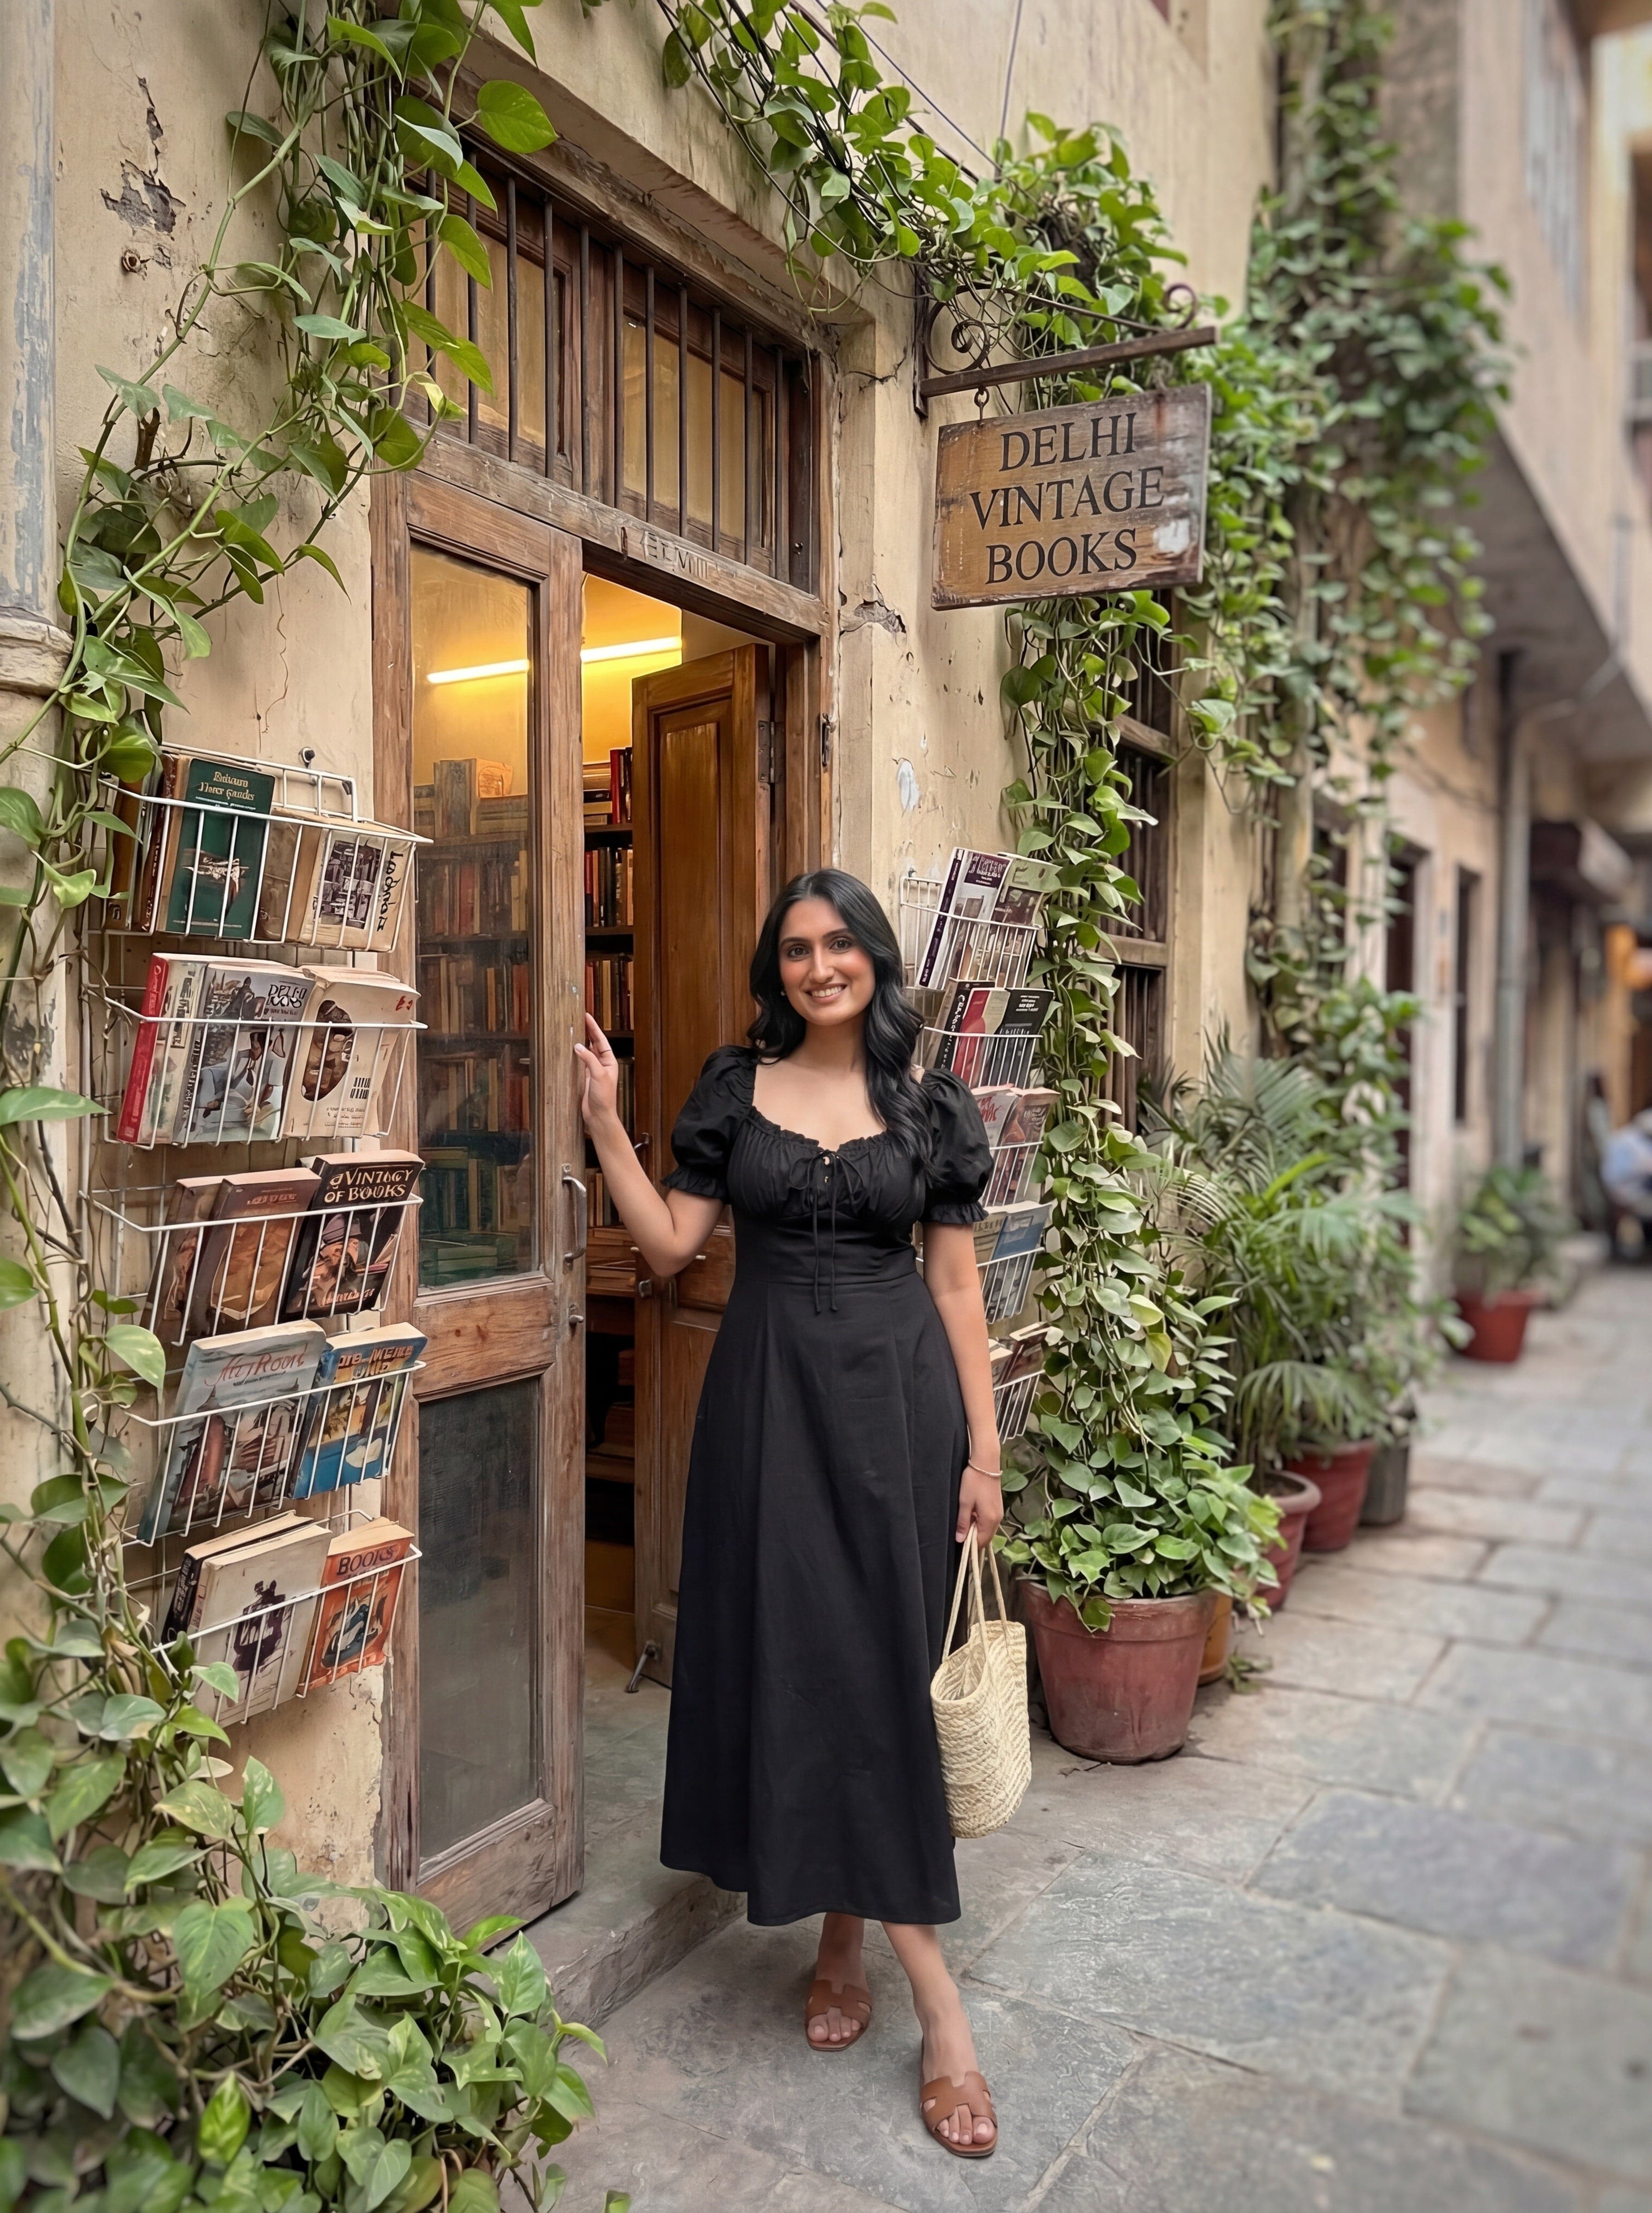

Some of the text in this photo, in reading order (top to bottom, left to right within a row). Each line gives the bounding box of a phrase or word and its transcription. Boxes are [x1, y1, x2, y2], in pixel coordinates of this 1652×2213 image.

[999, 413, 1137, 472] DELHI
[969, 466, 1165, 530] VINTAGE
[985, 527, 1137, 584] BOOKS
[324, 1191, 345, 1203] OF
